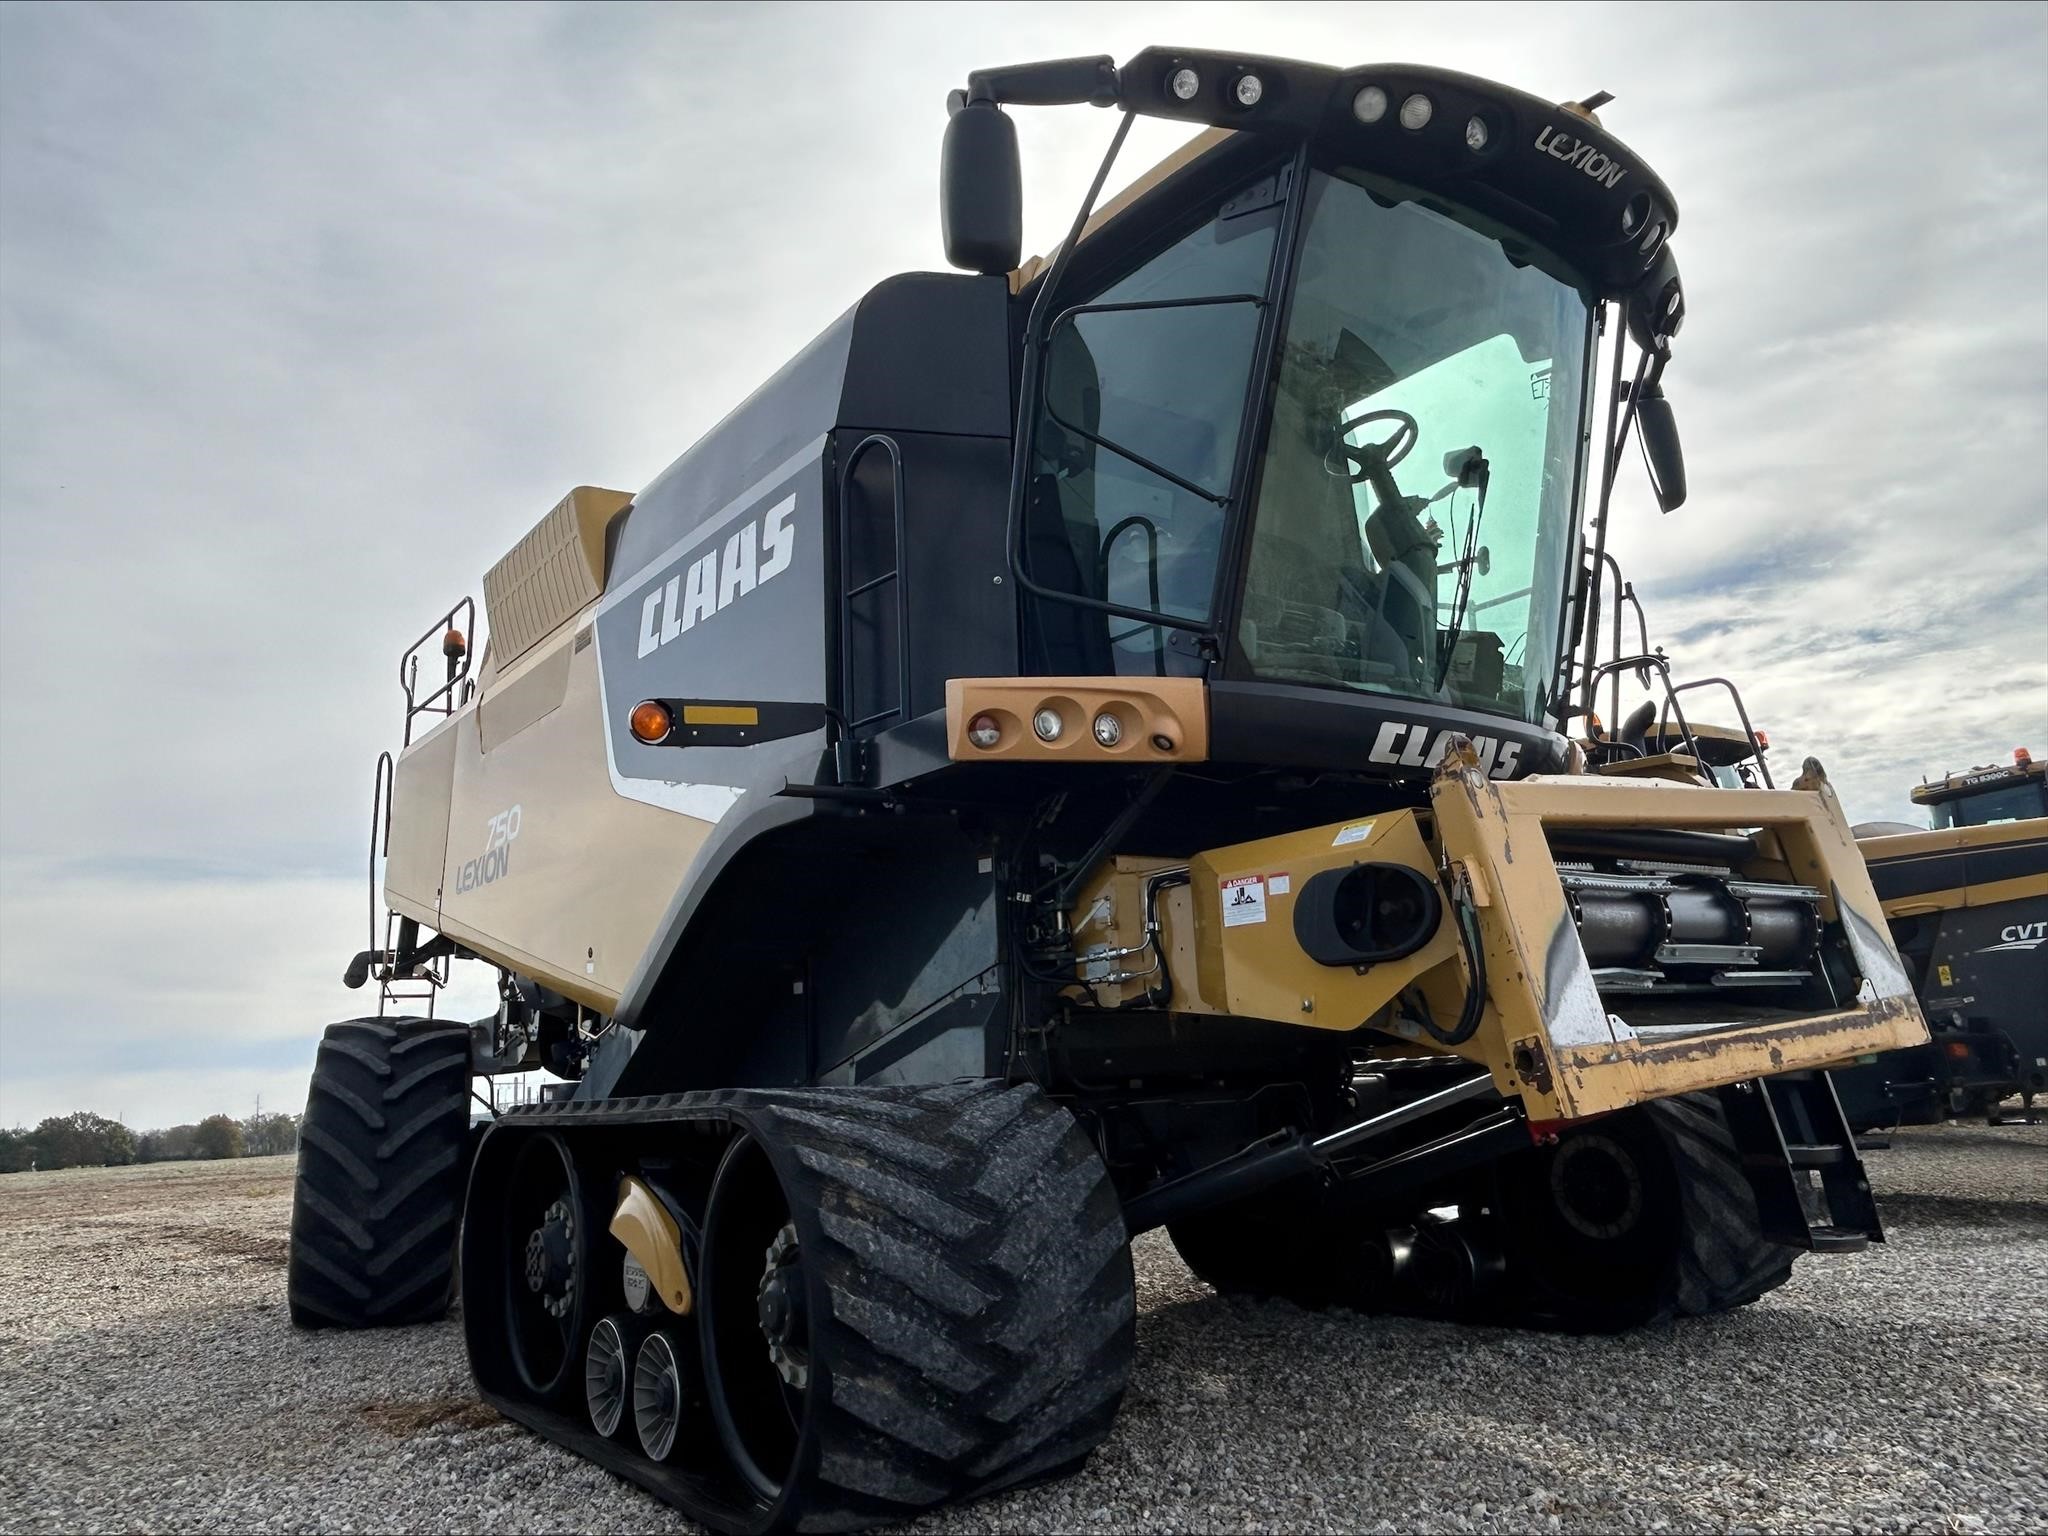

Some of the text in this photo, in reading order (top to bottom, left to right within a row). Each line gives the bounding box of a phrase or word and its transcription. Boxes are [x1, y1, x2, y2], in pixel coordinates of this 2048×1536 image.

[1534, 125, 1628, 189] LEXION
[638, 492, 796, 659] CLAAS
[486, 804, 521, 851] 750
[456, 842, 510, 895] LEXION
[1233, 876, 1257, 886] DANGER
[2001, 921, 2047, 941] CVT
